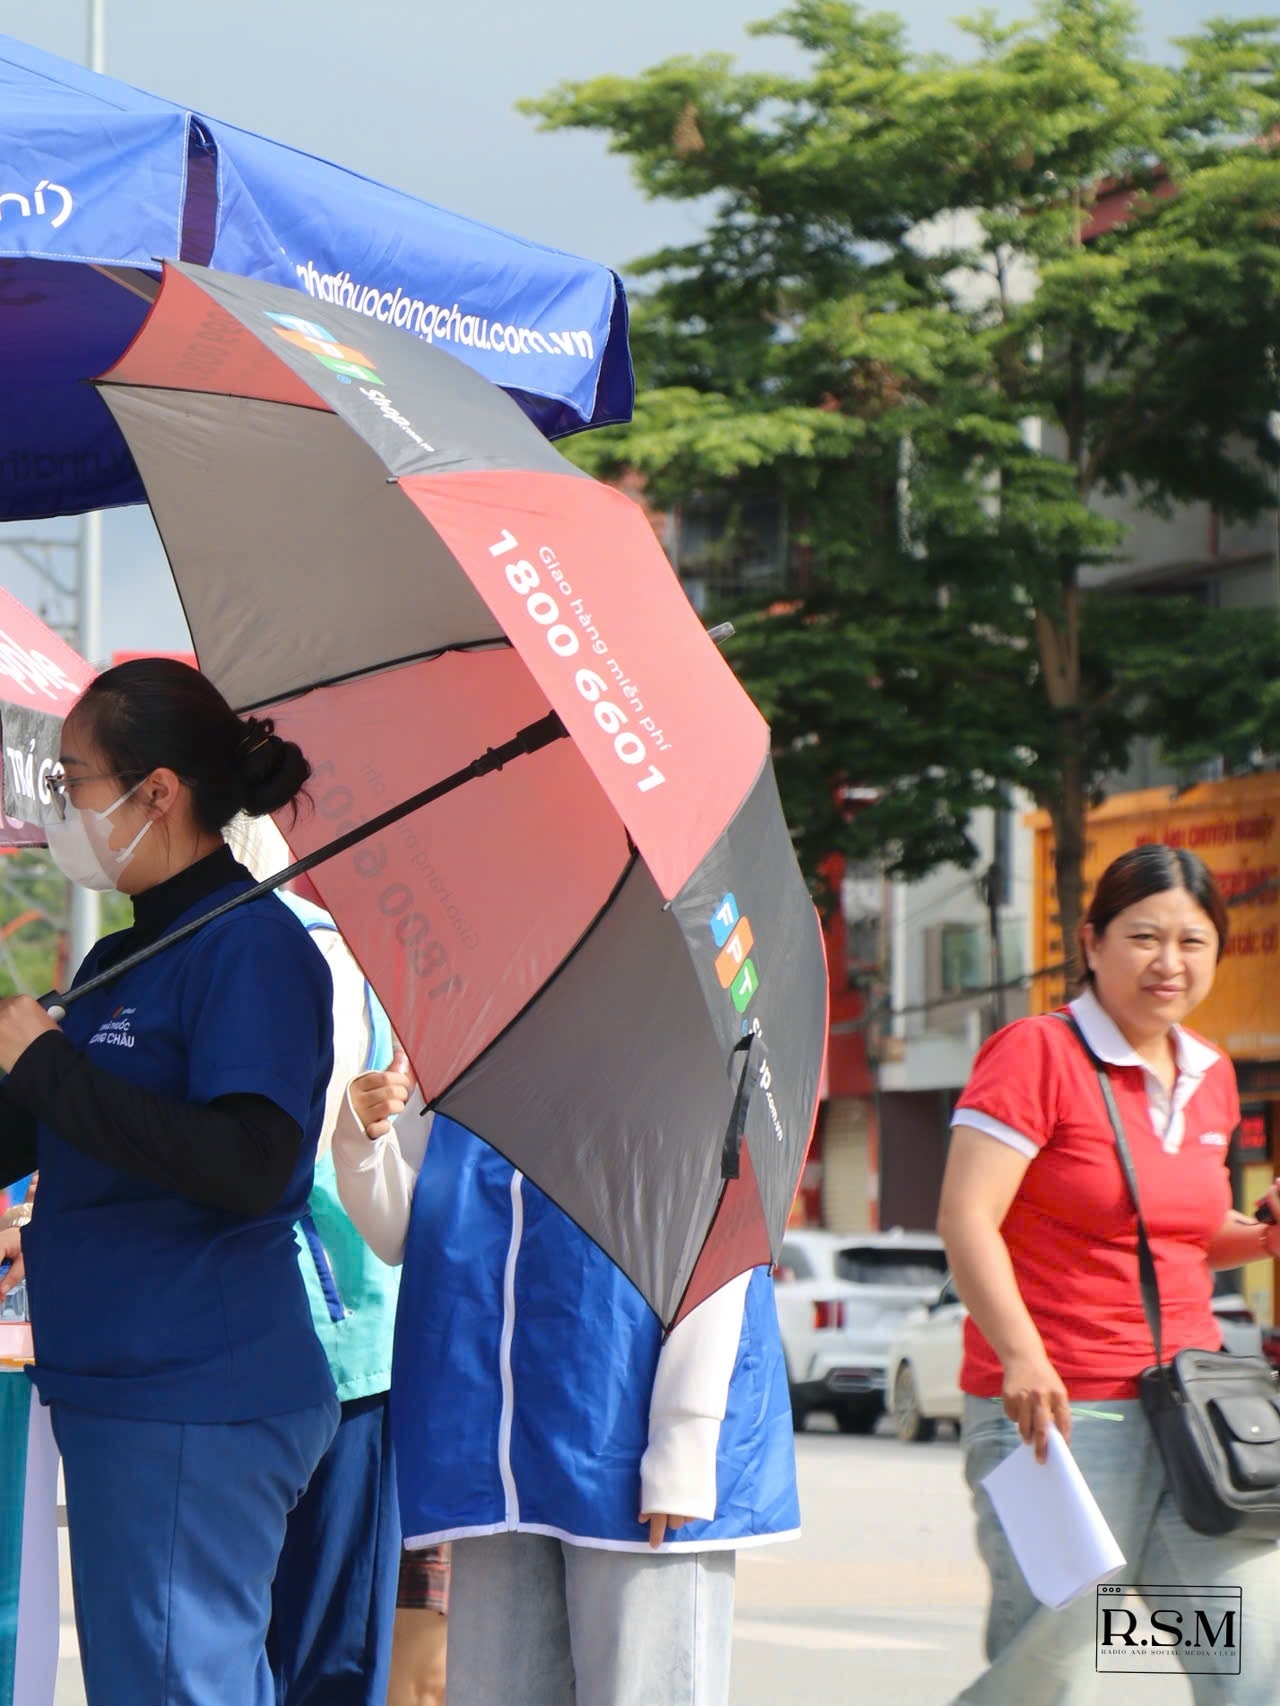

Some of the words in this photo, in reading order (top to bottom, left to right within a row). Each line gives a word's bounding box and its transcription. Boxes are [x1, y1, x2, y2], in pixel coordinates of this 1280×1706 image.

[488, 529, 579, 657] 1800
[575, 669, 666, 792] 6601
[538, 546, 572, 596] Giao
[570, 599, 608, 654] hàng
[640, 717, 672, 751] phí
[715, 899, 754, 1000] FPT
